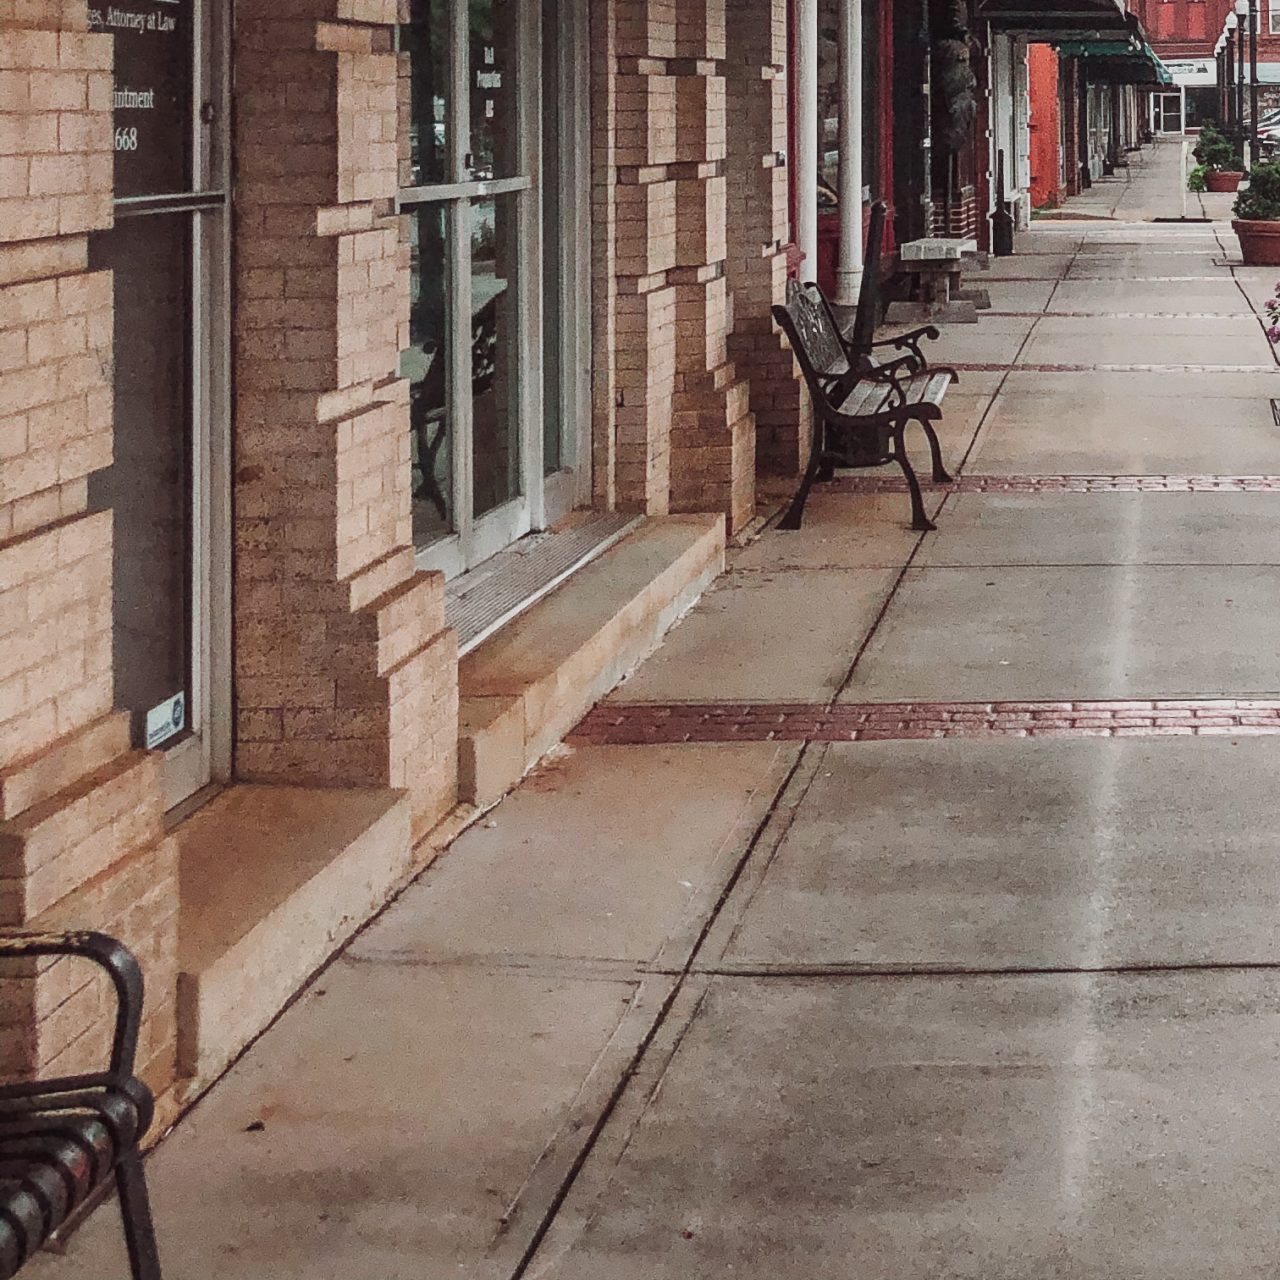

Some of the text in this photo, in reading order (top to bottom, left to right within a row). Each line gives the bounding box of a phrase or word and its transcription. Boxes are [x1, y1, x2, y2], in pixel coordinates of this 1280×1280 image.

[106, 5, 146, 34] Attorney
[147, 11, 156, 31] at
[158, 10, 176, 32] Law
[115, 127, 138, 151] 668
